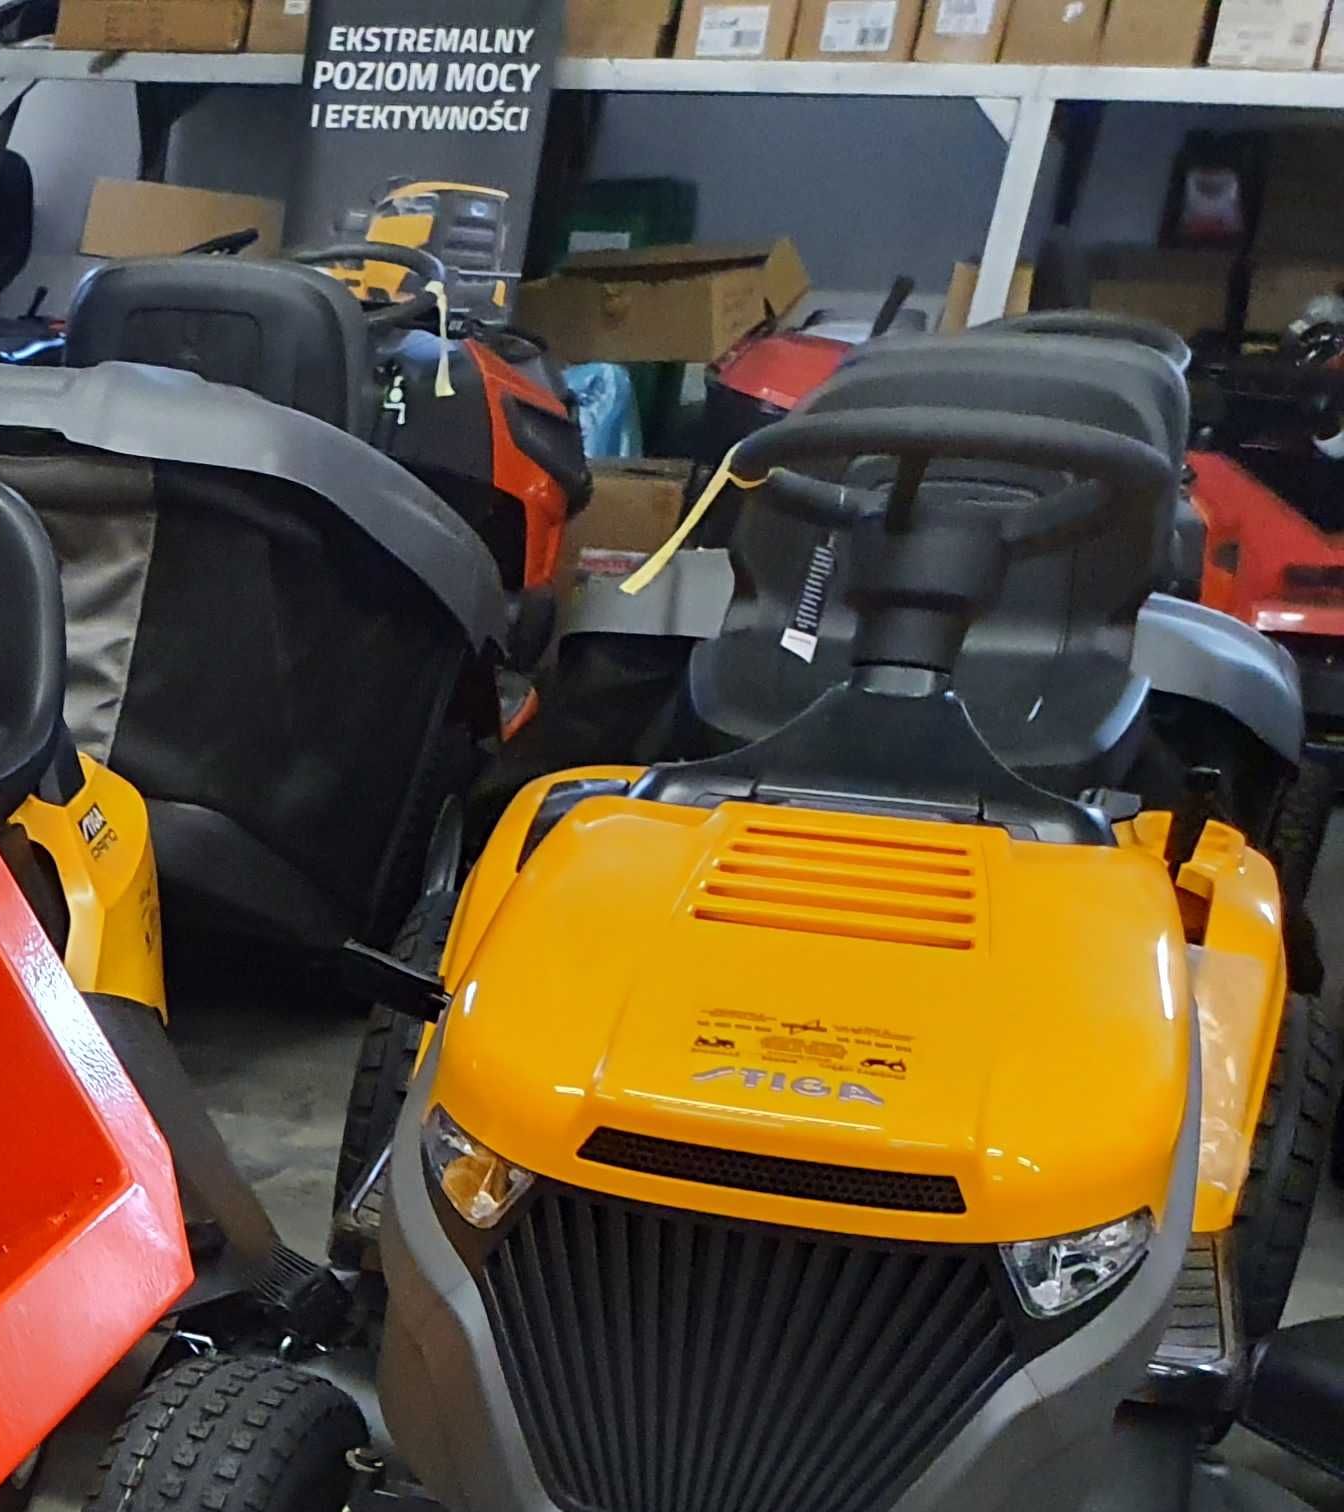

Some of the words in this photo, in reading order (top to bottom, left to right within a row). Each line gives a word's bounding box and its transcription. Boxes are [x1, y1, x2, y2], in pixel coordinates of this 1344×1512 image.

[328, 26, 535, 54] EKSTREMALNY
[313, 60, 439, 92] POZIOM
[444, 62, 542, 93] MOCY
[311, 103, 320, 128] I
[325, 99, 530, 132] EFEKTYWNOŚCI
[691, 1066, 886, 1107] STIGA
